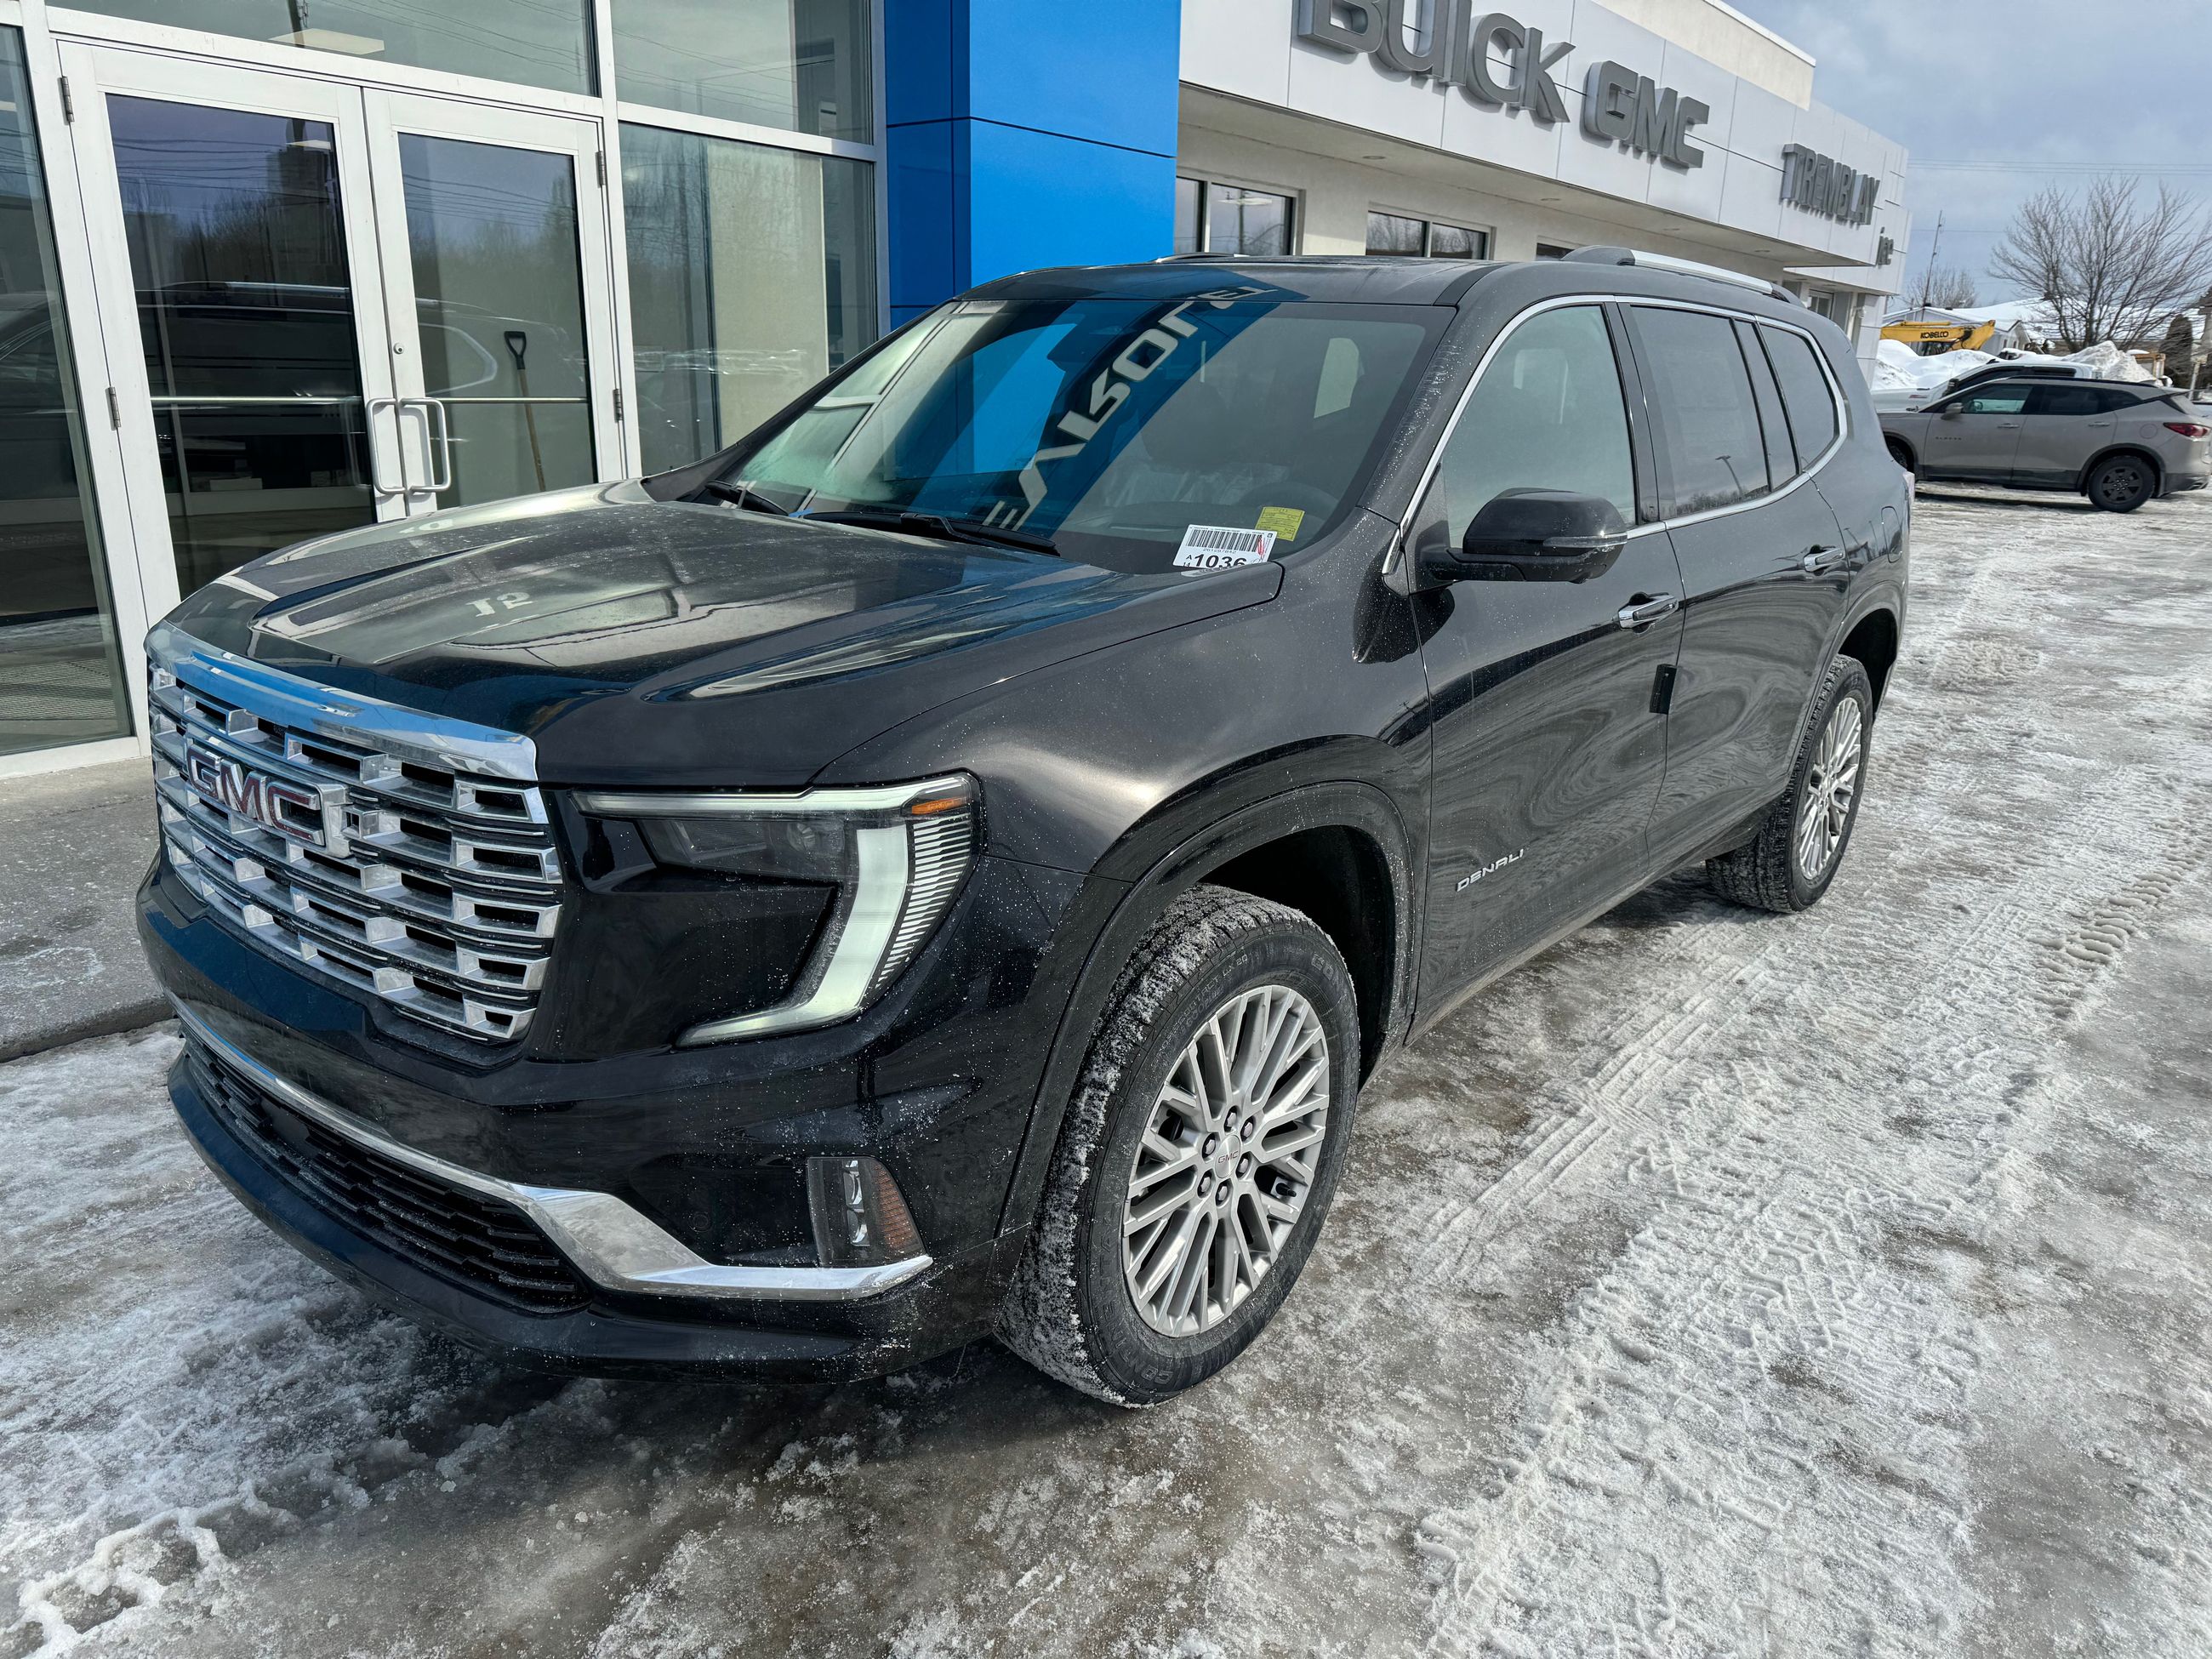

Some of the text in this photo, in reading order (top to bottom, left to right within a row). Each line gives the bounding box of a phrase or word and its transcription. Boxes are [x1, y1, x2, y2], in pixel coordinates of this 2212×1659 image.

[1583, 60, 1710, 168] GMC
[1780, 143, 1880, 225] TREMBLAY
[1194, 554, 1246, 568] 1036
[187, 744, 326, 847] GMC
[1456, 848, 1524, 892] DENALI
[1217, 1150, 1239, 1163] GMC
